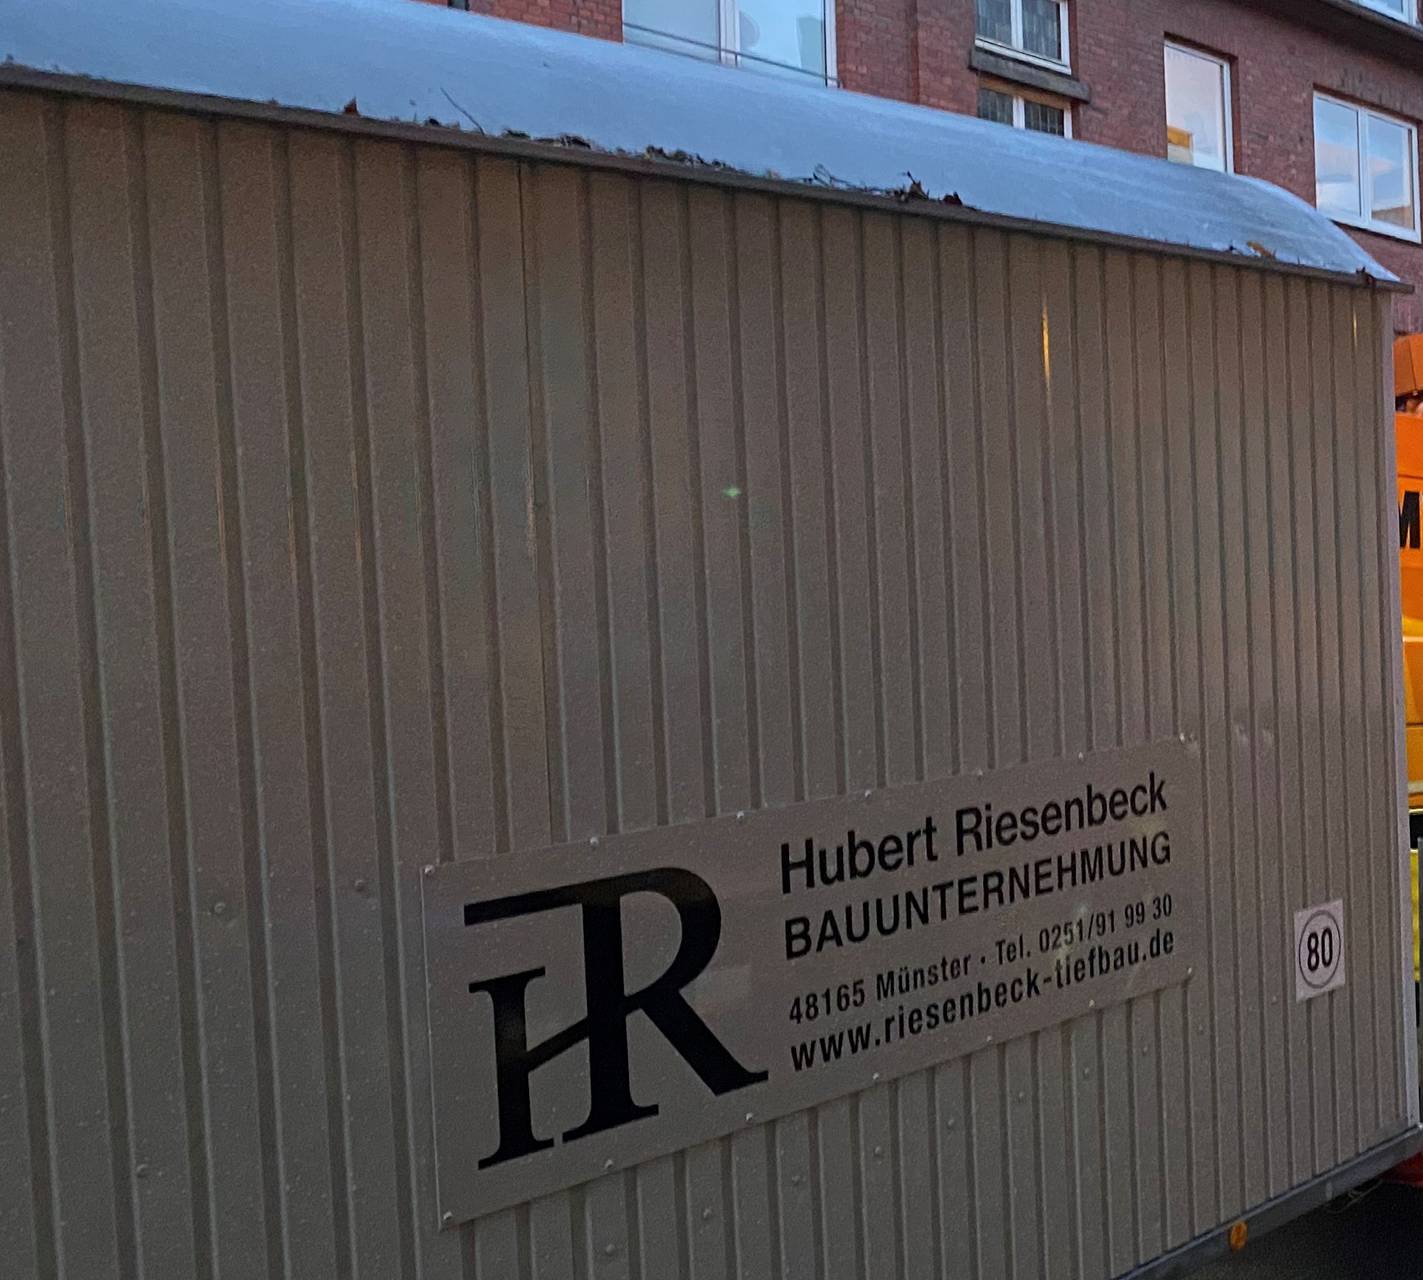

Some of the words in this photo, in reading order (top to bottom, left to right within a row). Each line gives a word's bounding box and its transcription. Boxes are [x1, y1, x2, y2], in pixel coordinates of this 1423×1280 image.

[781, 816, 939, 894] Hubert
[956, 771, 1168, 857] Riesenbeck
[785, 831, 1171, 960] BAUUNTERNEHMUNG
[789, 979, 865, 1024] 48165
[876, 954, 971, 1001] Münster
[995, 934, 1031, 966] Tel.
[1038, 909, 1116, 952] 0251/91
[1124, 900, 1146, 928] 99
[1152, 893, 1173, 921] 30
[790, 928, 1175, 1072] www.riesenbeck-tiefbau.de
[1307, 926, 1333, 973] 80
